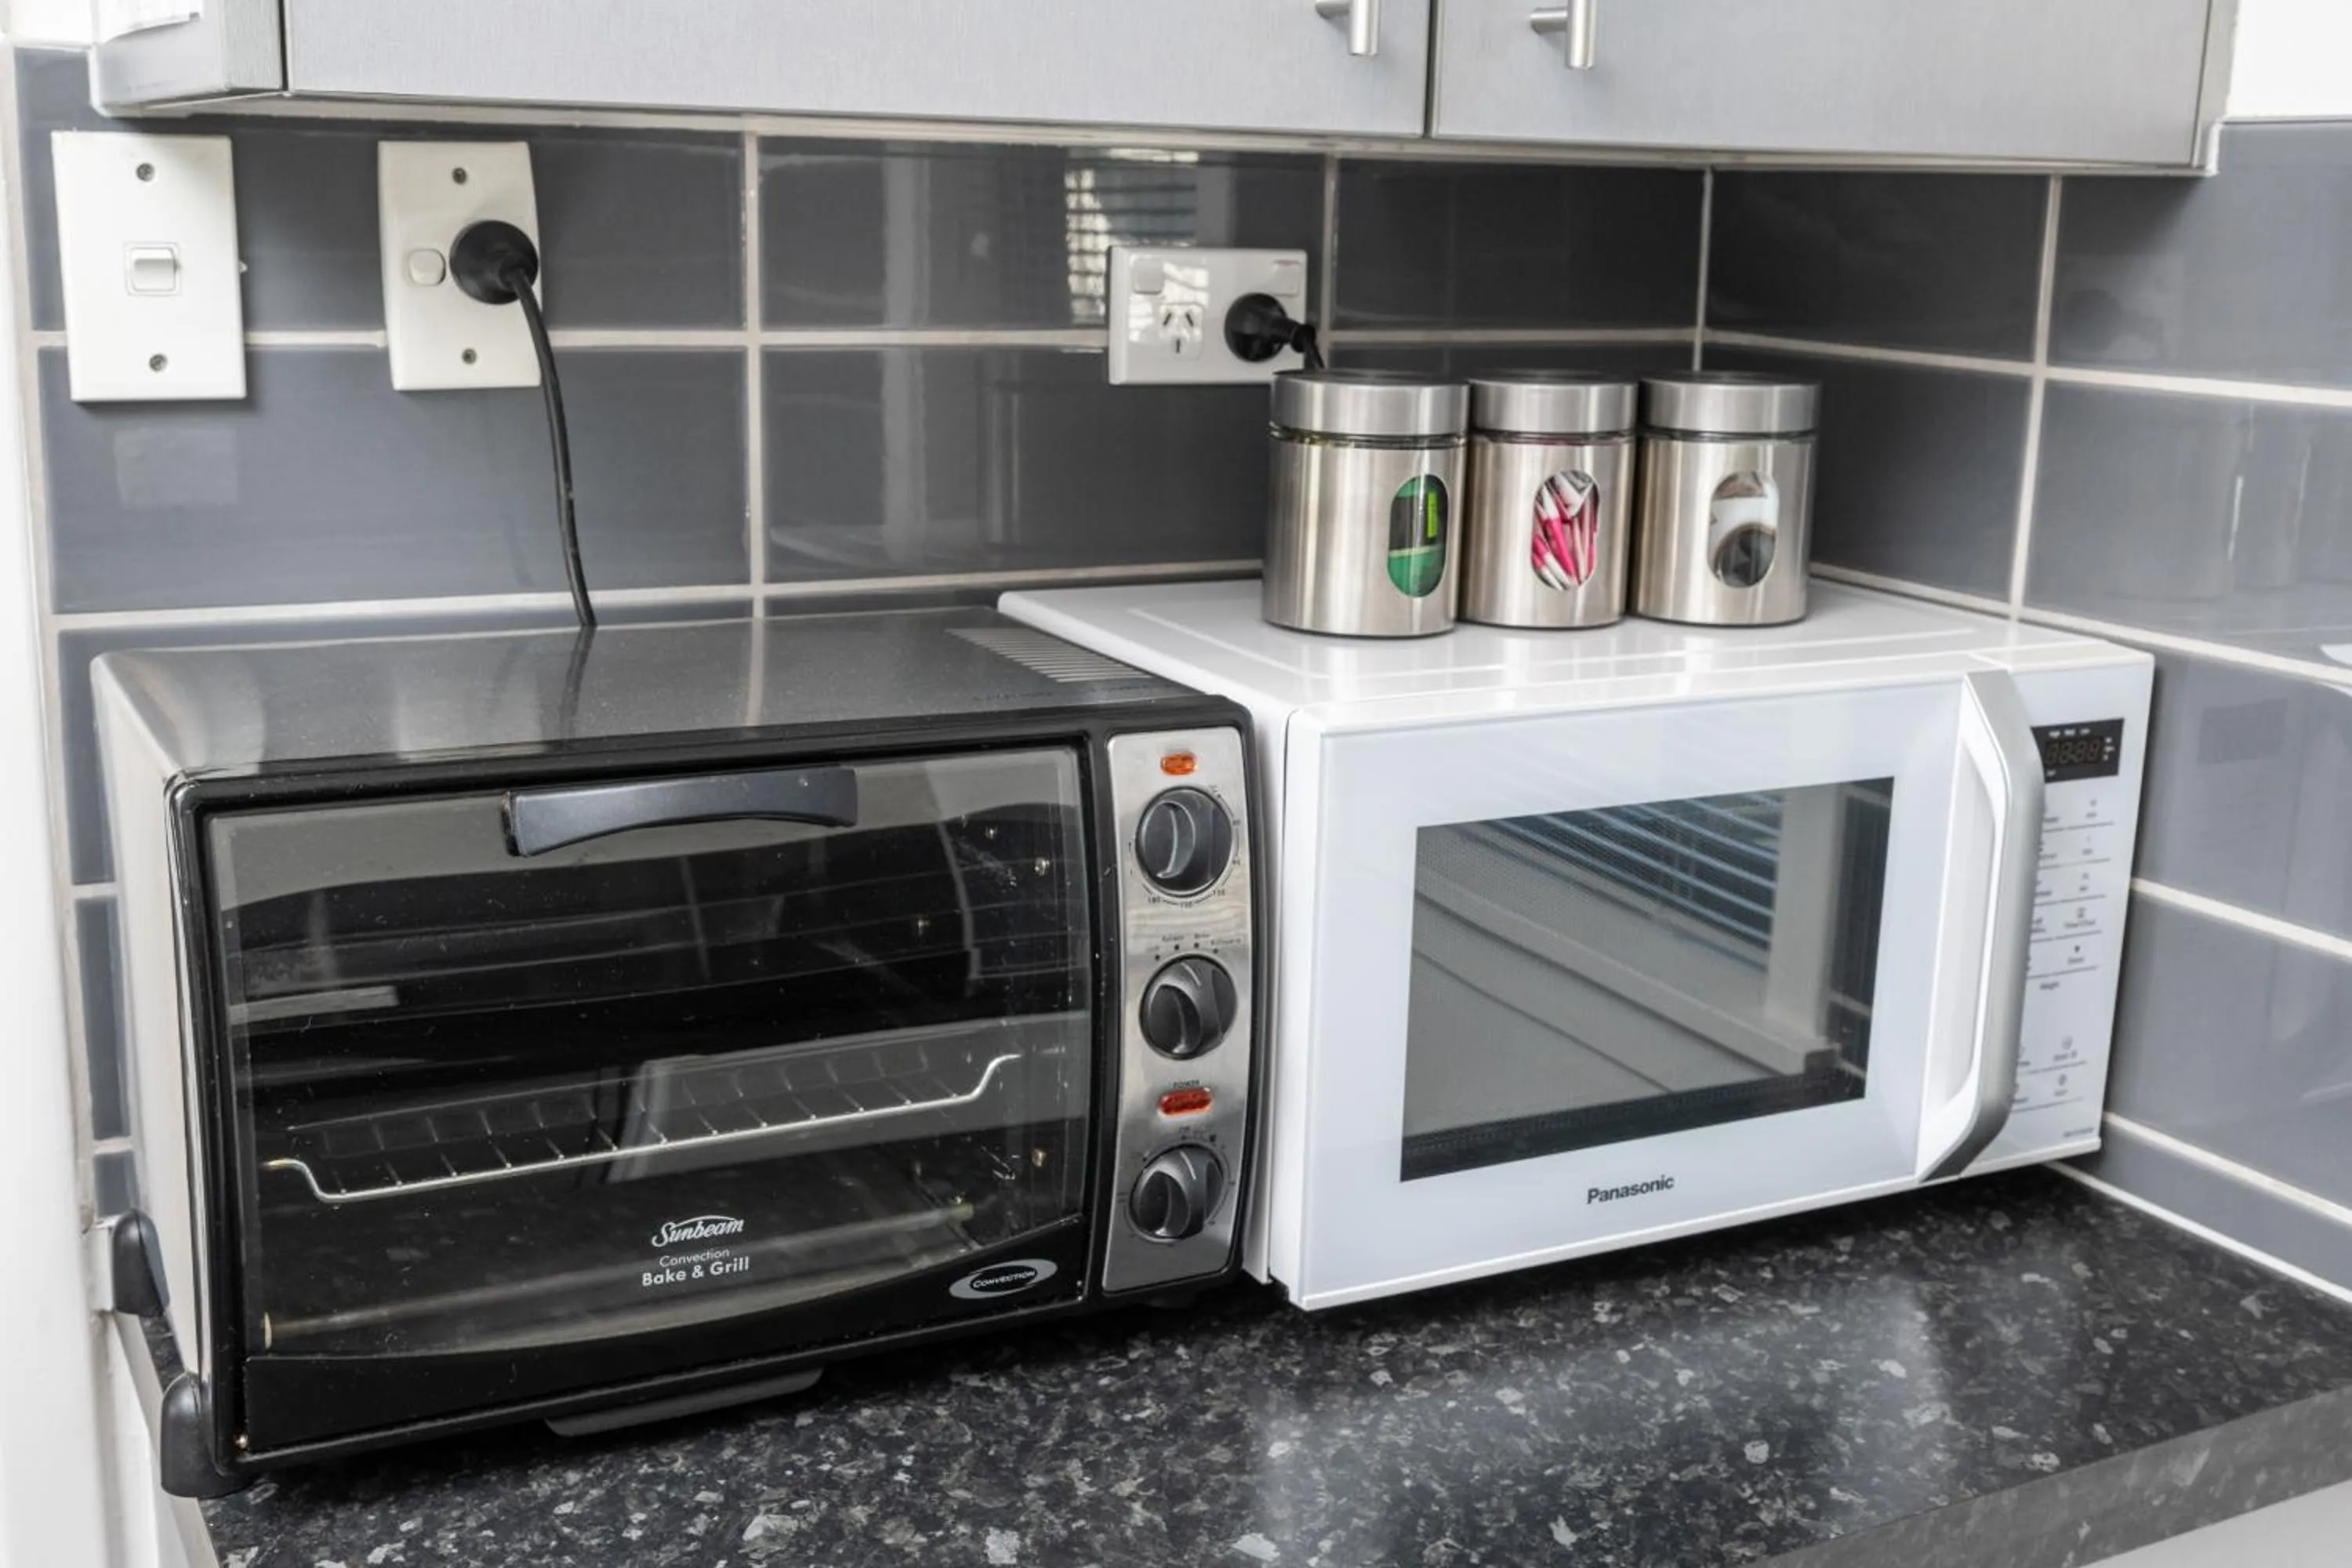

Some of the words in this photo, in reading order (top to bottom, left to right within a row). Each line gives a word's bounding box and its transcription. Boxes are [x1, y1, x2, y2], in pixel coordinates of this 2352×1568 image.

[1587, 1174, 1675, 1205] Panasonic
[652, 1215, 745, 1247] Sunbeam
[642, 1268, 687, 1287] Bake
[691, 1265, 704, 1279] &
[710, 1255, 750, 1276] Grill
[659, 1248, 731, 1268] Convection
